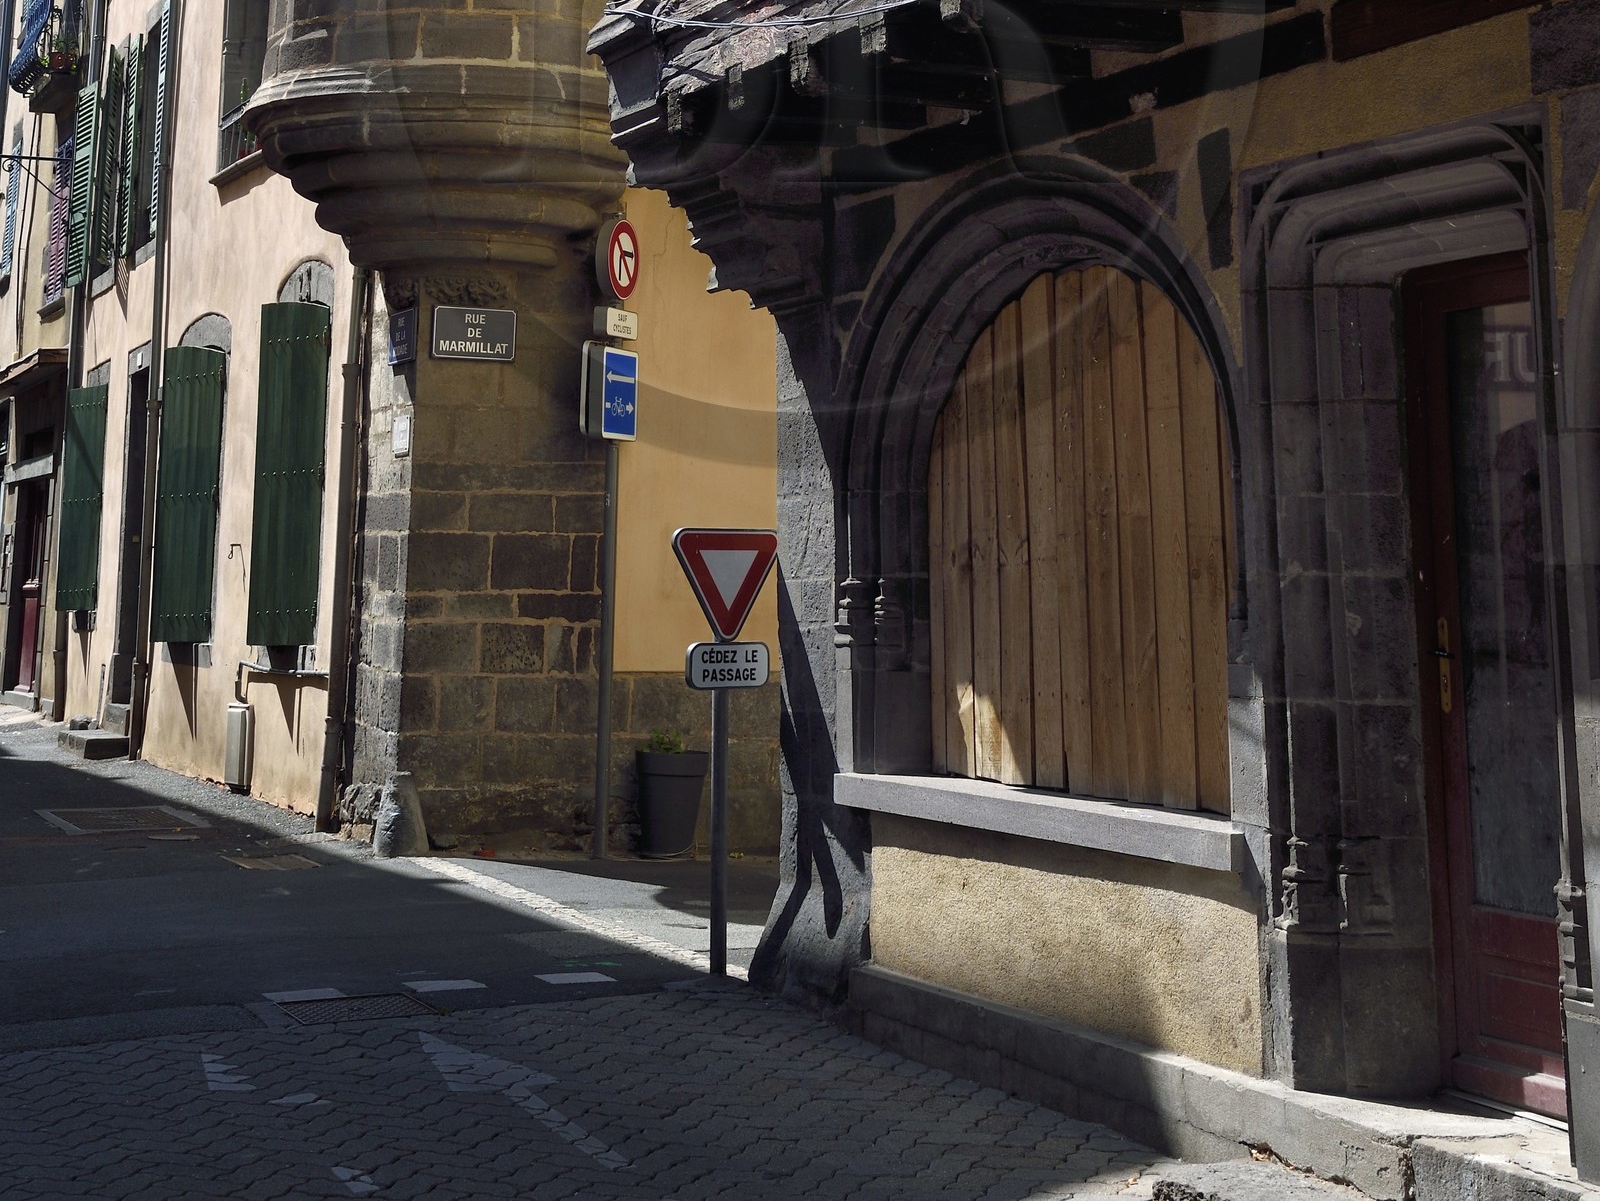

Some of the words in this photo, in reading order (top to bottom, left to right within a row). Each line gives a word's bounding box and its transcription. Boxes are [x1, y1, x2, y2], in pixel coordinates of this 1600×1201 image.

[397, 316, 405, 327] RUE
[465, 313, 486, 325] RUE
[617, 313, 628, 322] SAUF
[467, 327, 482, 338] DE
[613, 323, 631, 334] CYCLISTES
[396, 332, 401, 341] DE
[401, 330, 406, 340] LA
[439, 340, 509, 355] MARMILLAT
[701, 647, 738, 664] CÉDEZ
[745, 649, 758, 663] LE
[702, 667, 757, 683] PASSAGE
